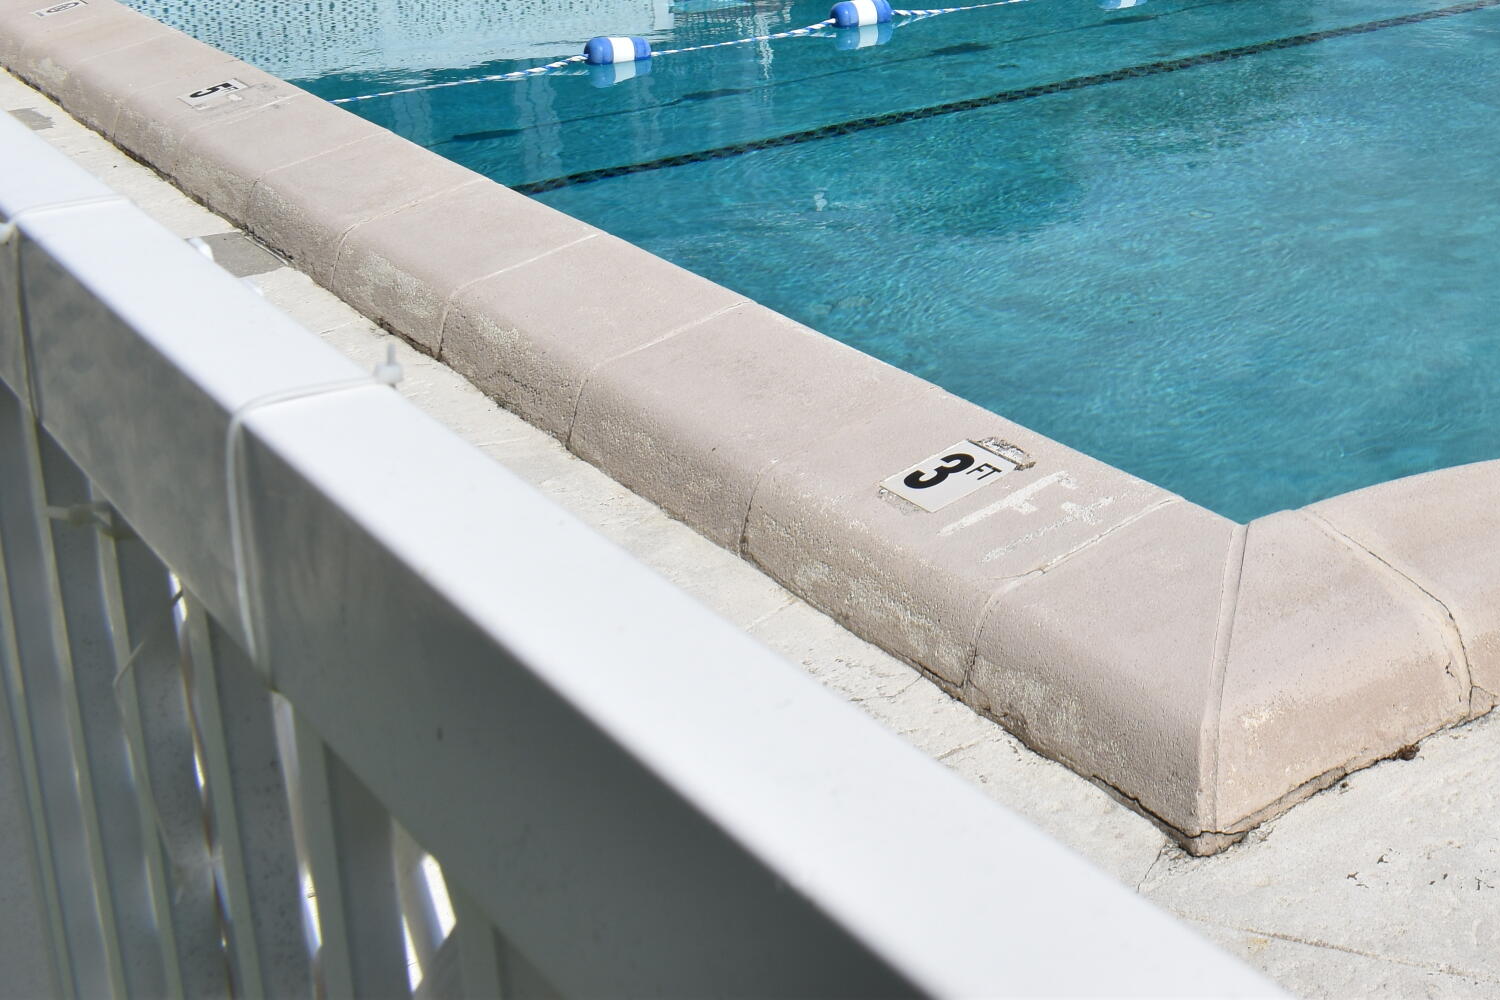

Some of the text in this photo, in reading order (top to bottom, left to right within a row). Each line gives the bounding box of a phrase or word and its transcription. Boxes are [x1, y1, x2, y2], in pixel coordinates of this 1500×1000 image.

[190, 82, 232, 98] 5
[904, 454, 1002, 490] 3 FT
